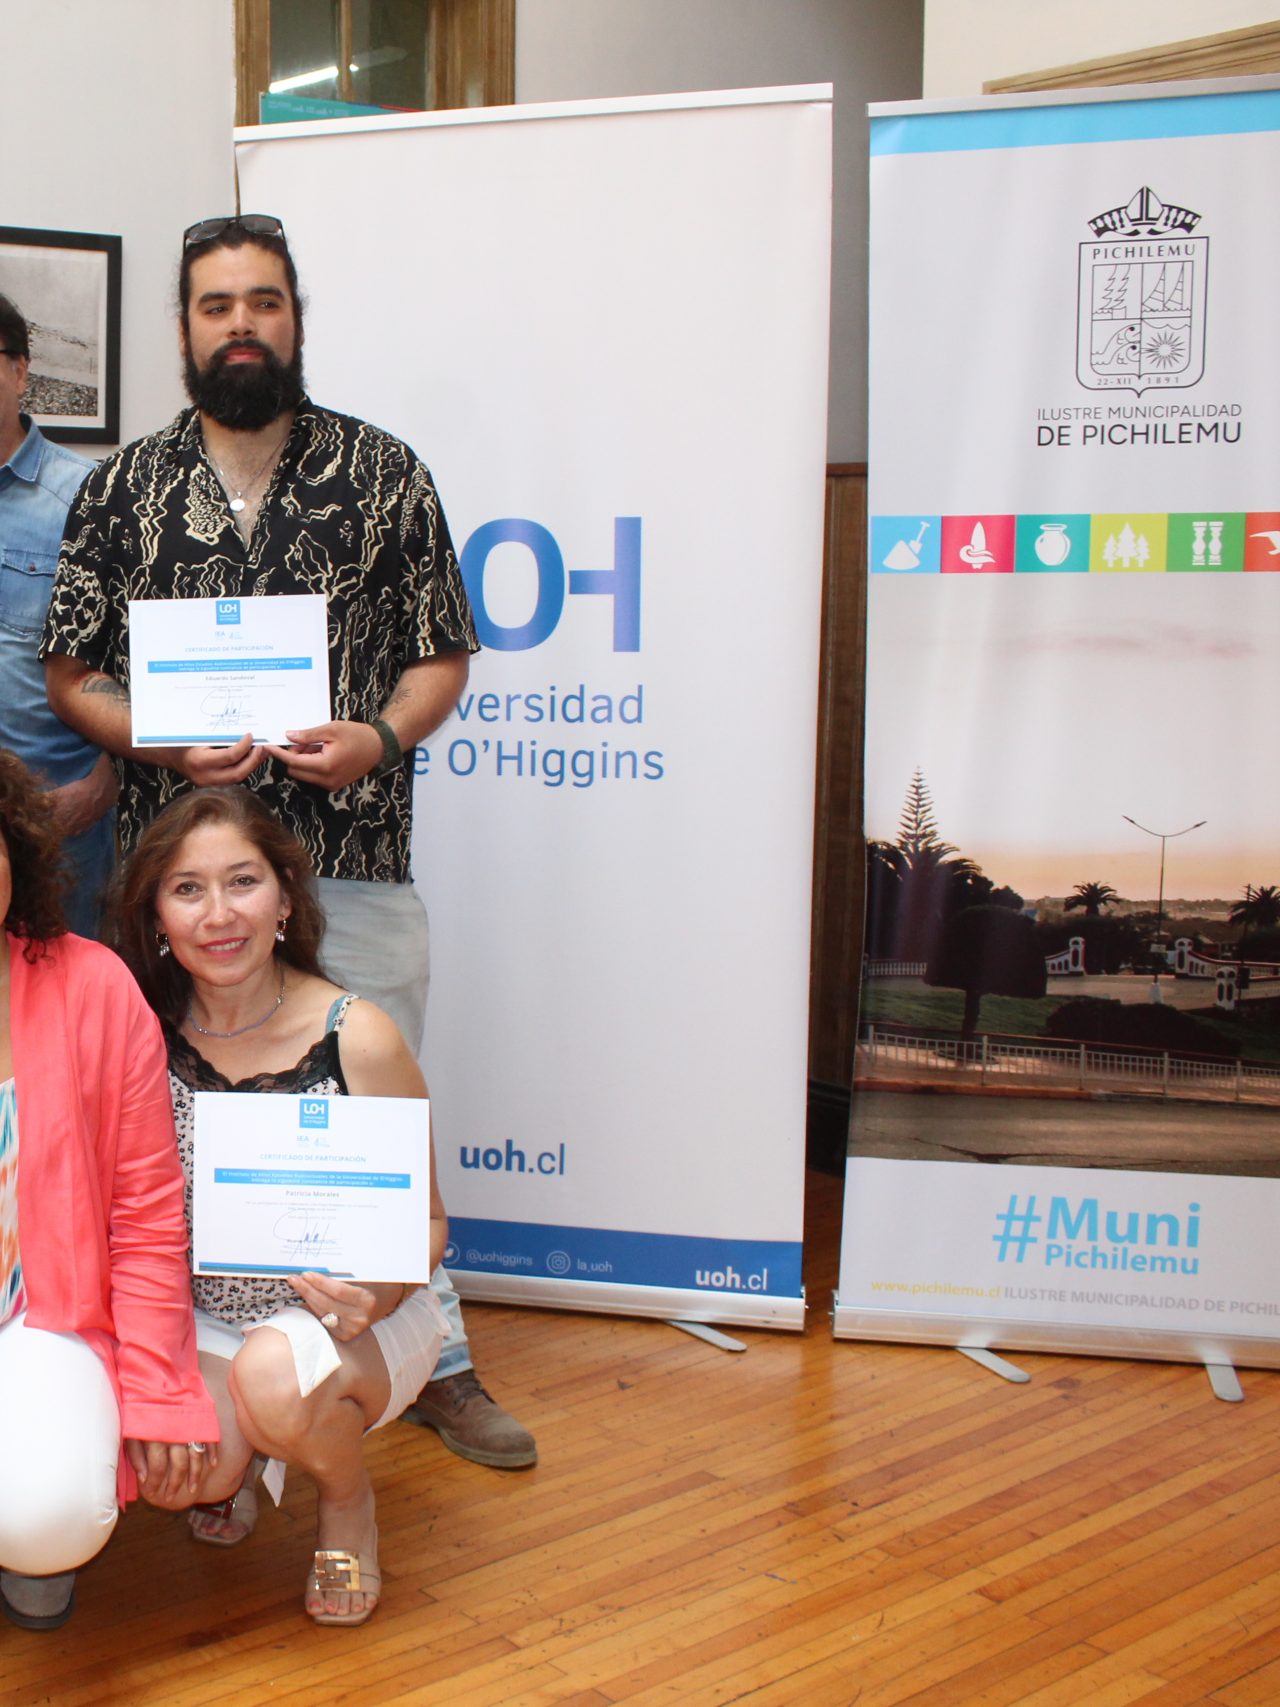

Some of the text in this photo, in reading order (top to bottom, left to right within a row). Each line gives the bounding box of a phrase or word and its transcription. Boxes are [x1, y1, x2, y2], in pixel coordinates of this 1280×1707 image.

[1092, 243, 1196, 260] PICHILEMU
[1037, 402, 1242, 421] ILUSTRE MUNICIPALIDAD
[1037, 421, 1242, 447] DE PICHILEMU
[458, 516, 642, 653] OH
[456, 684, 644, 724] versidad
[414, 746, 430, 776] e
[260, 1153, 303, 1161] CERTIFICADO
[459, 1138, 566, 1176] uoh.cl
[992, 1194, 1201, 1263] #Muni
[466, 1248, 533, 1267] @uohiggins
[1044, 1243, 1200, 1275] Pichilemu
[695, 1265, 768, 1291] uoh.cl
[871, 1280, 1000, 1298] www.pichilemu.cl
[1004, 1286, 1067, 1304] ILUSTRE
[1070, 1290, 1200, 1311] MUNICIPALIDAD
[1204, 1298, 1226, 1312] DE
